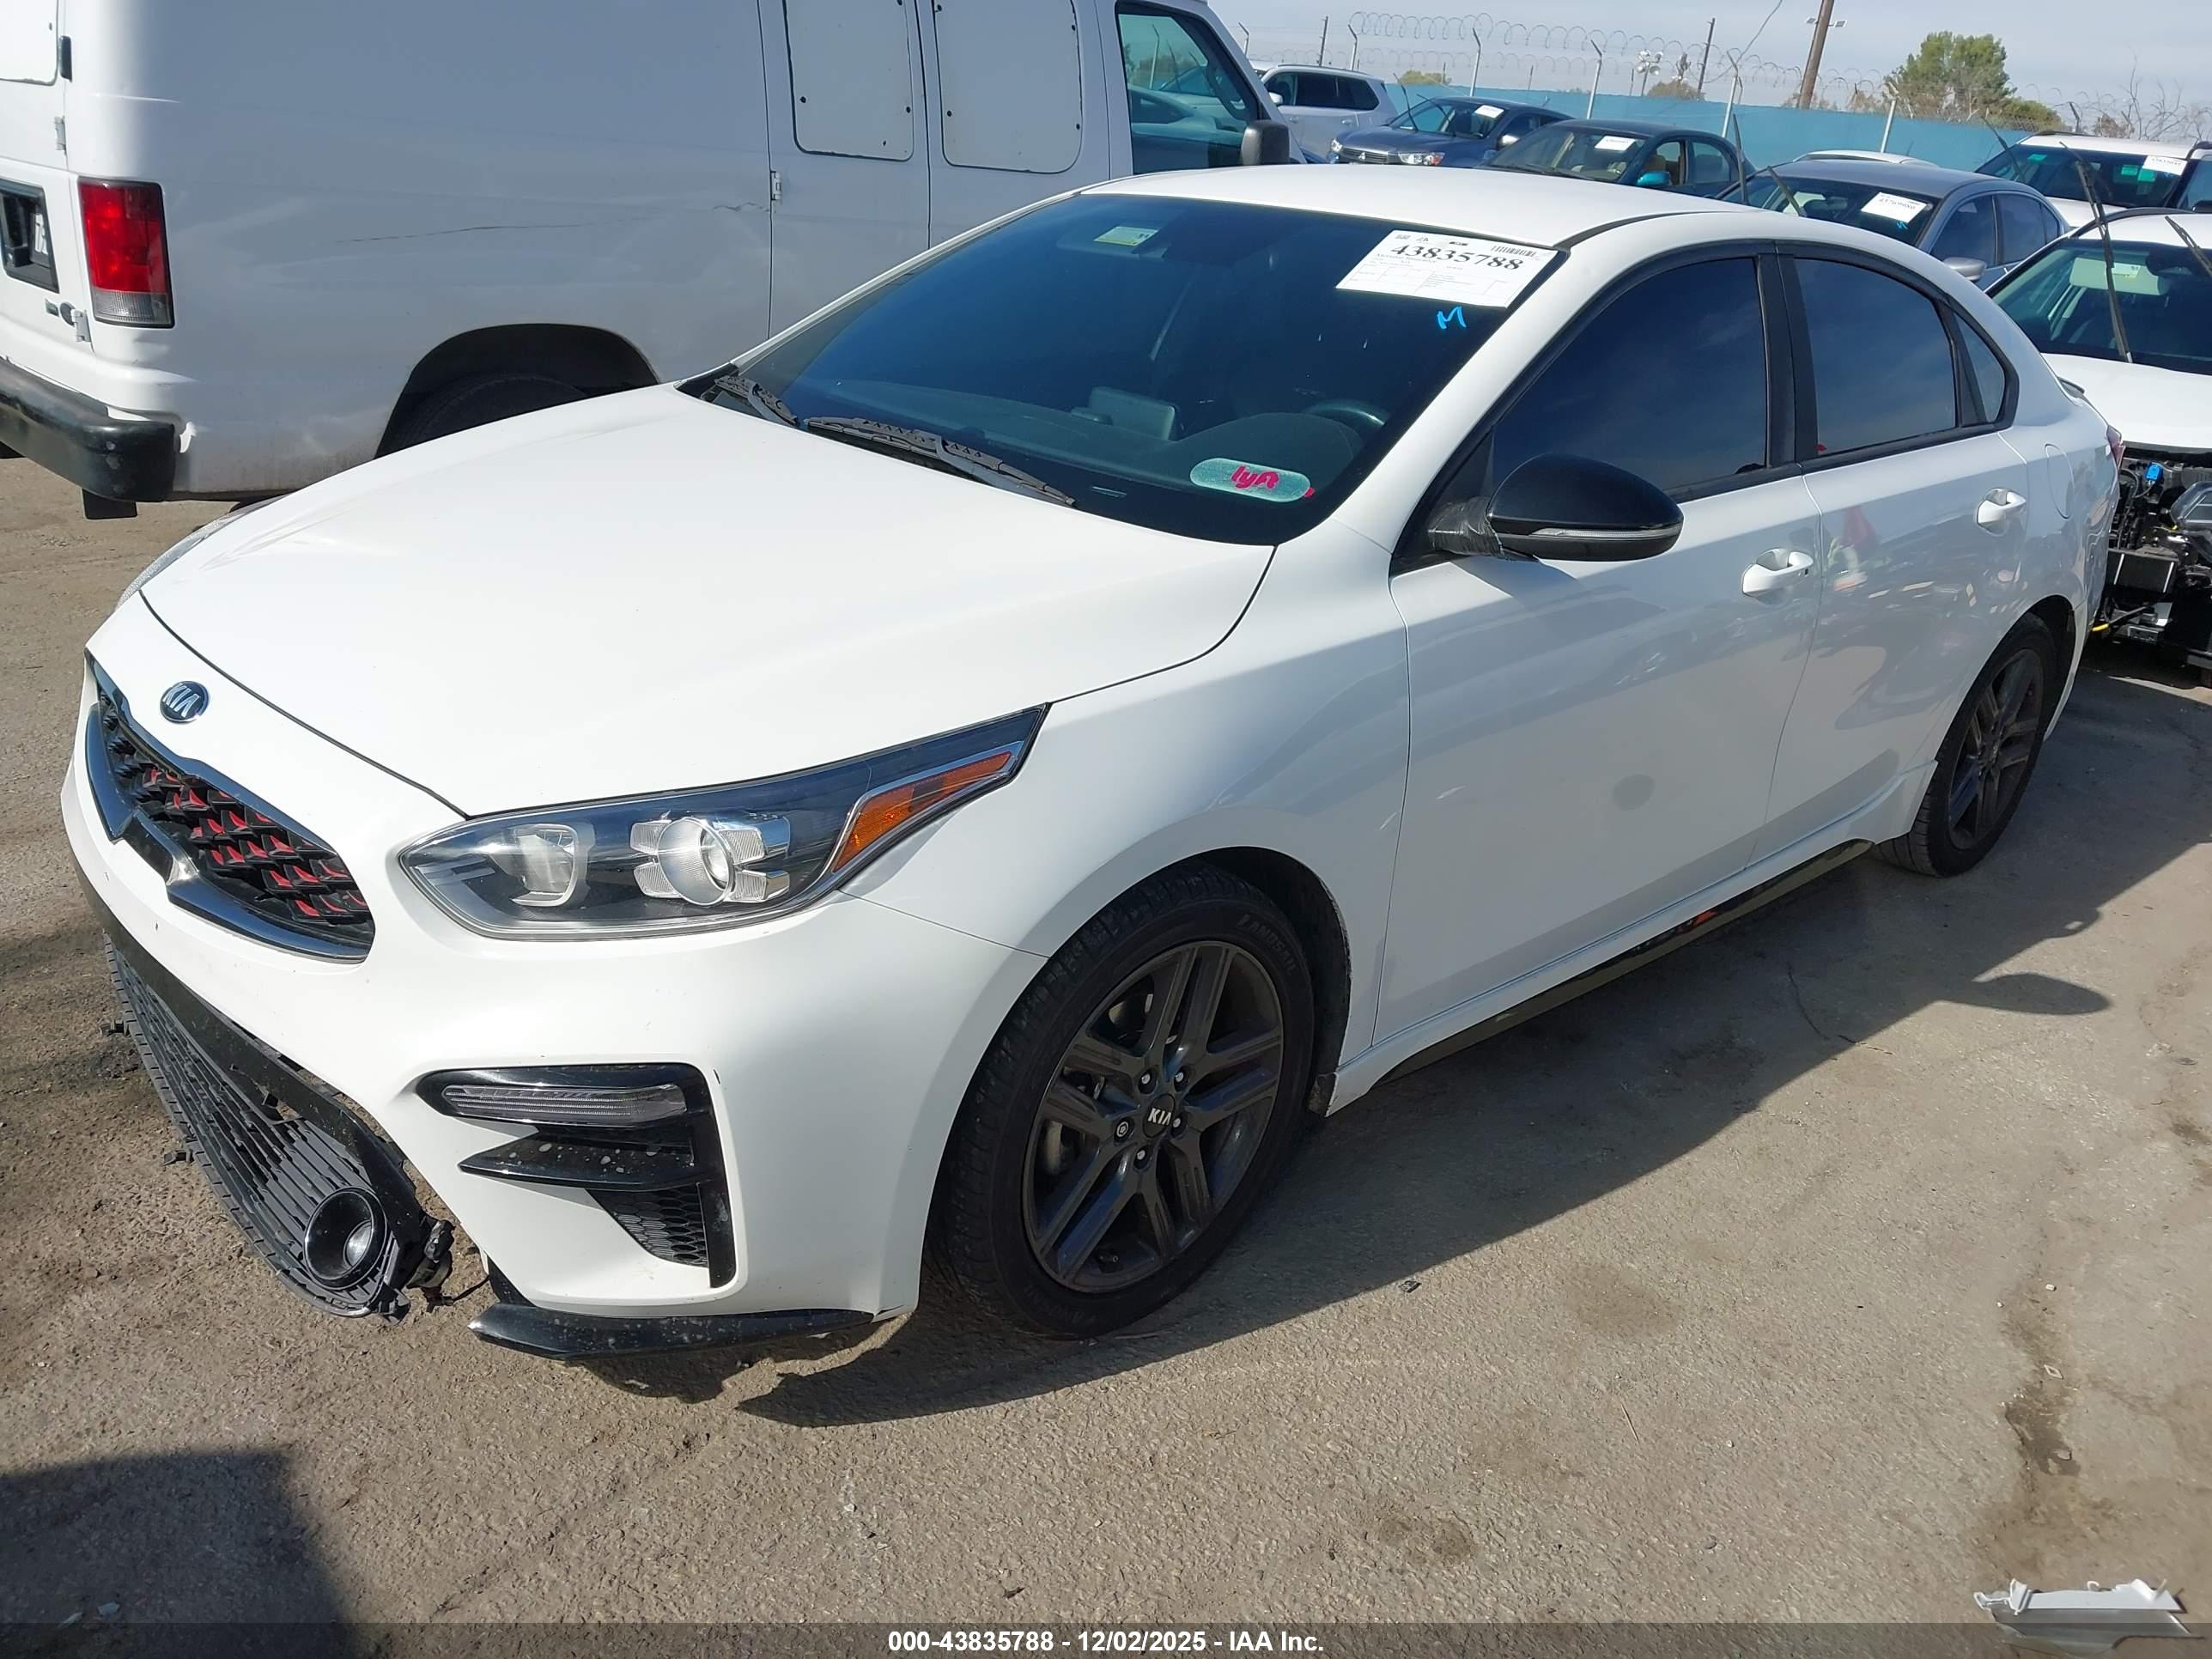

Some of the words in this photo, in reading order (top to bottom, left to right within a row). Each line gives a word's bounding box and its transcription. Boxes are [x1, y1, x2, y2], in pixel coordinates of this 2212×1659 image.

[1391, 245, 1523, 270] 43835788
[1436, 306, 1467, 330] M
[162, 683, 200, 718] KIA
[1147, 1108, 1172, 1126] KIA
